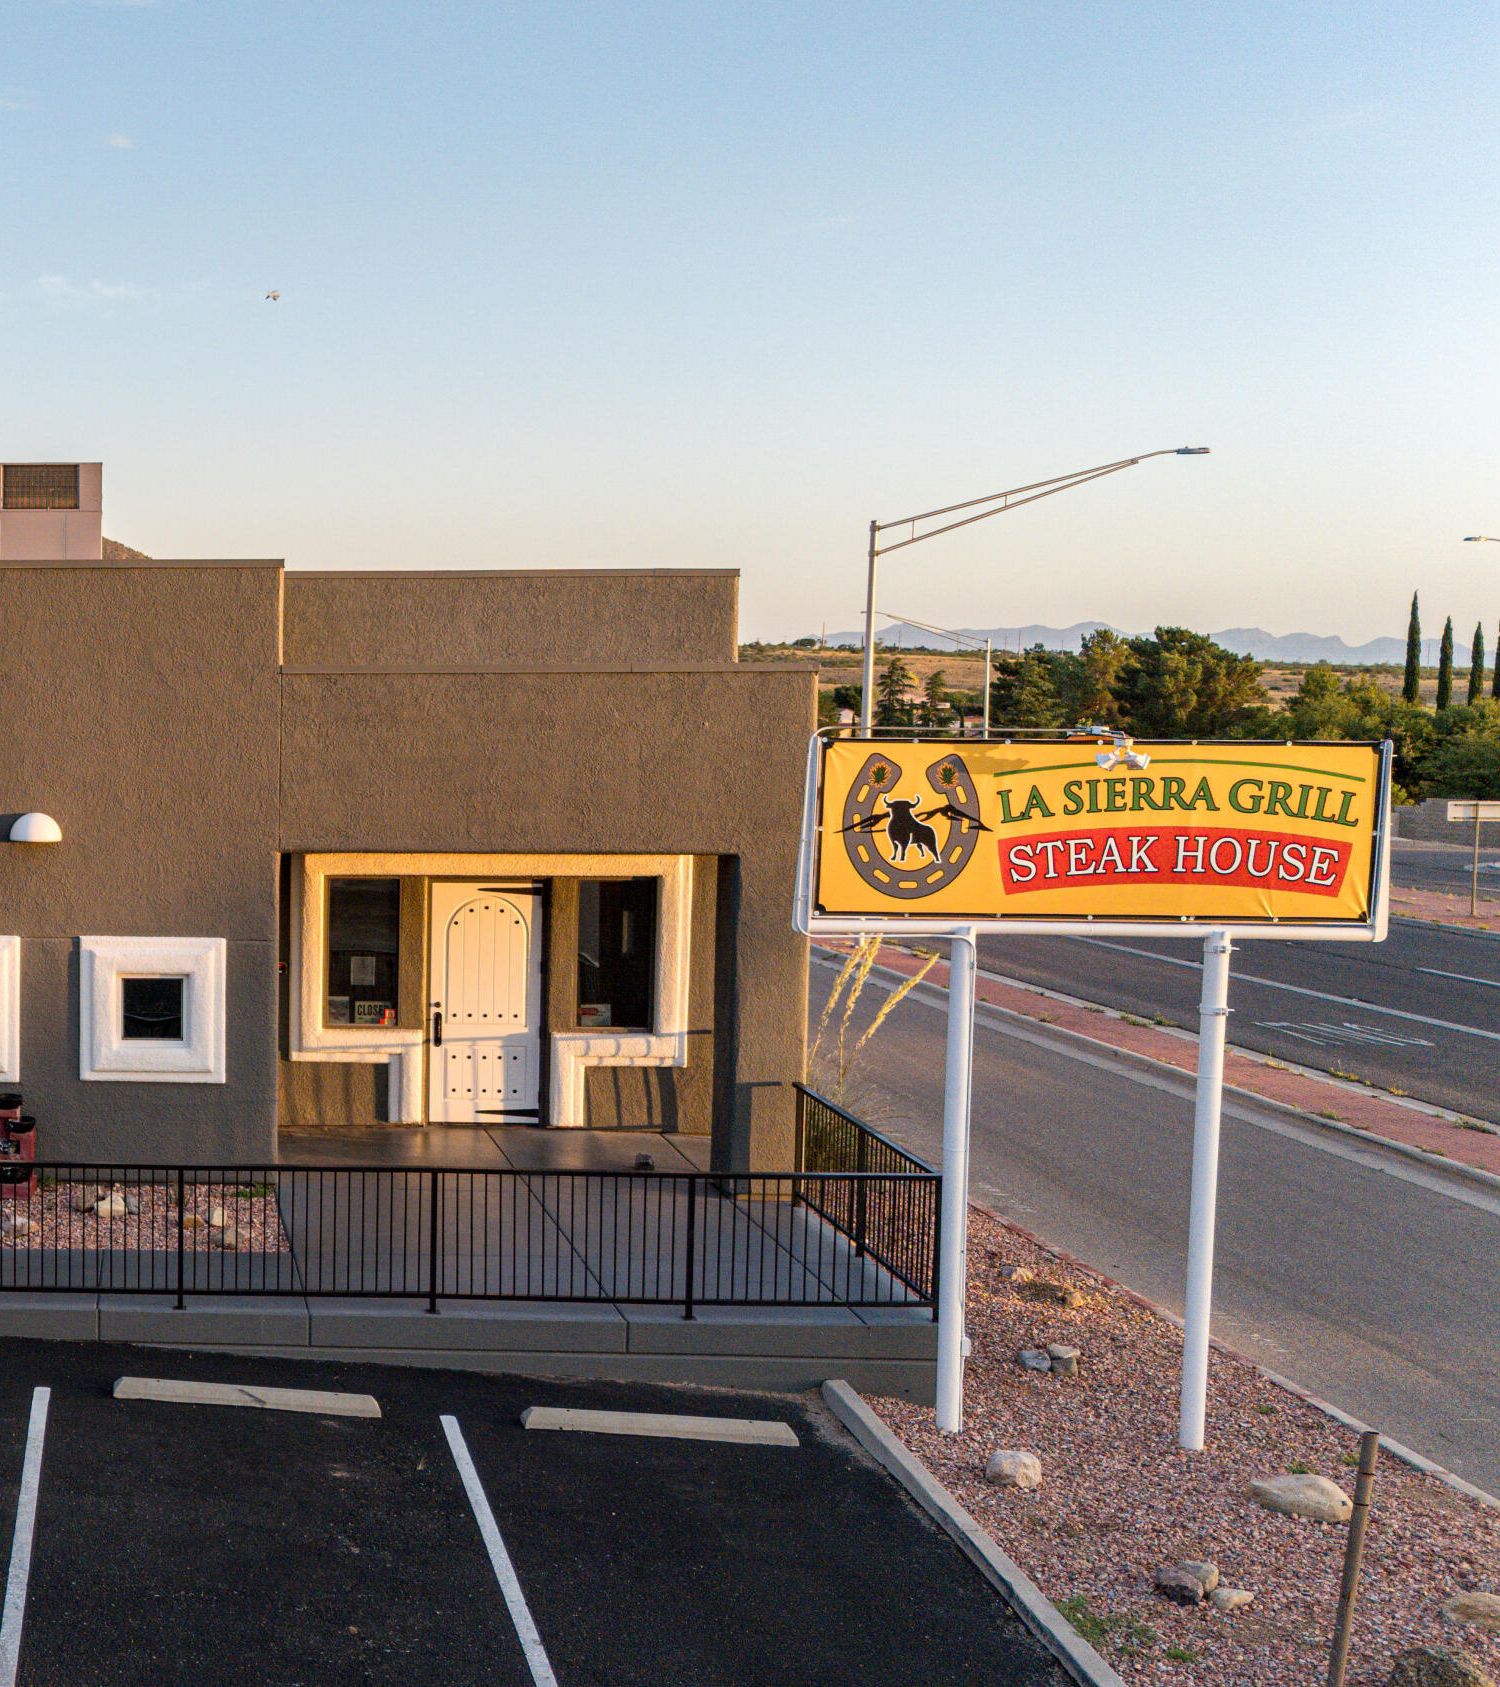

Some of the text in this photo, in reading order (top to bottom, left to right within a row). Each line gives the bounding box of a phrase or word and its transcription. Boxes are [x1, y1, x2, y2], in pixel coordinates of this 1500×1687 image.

[997, 776, 1359, 827] LA SIERRA GRILL
[1008, 836, 1340, 886] STEAK HOUSE
[357, 1004, 389, 1016] CLOSE
